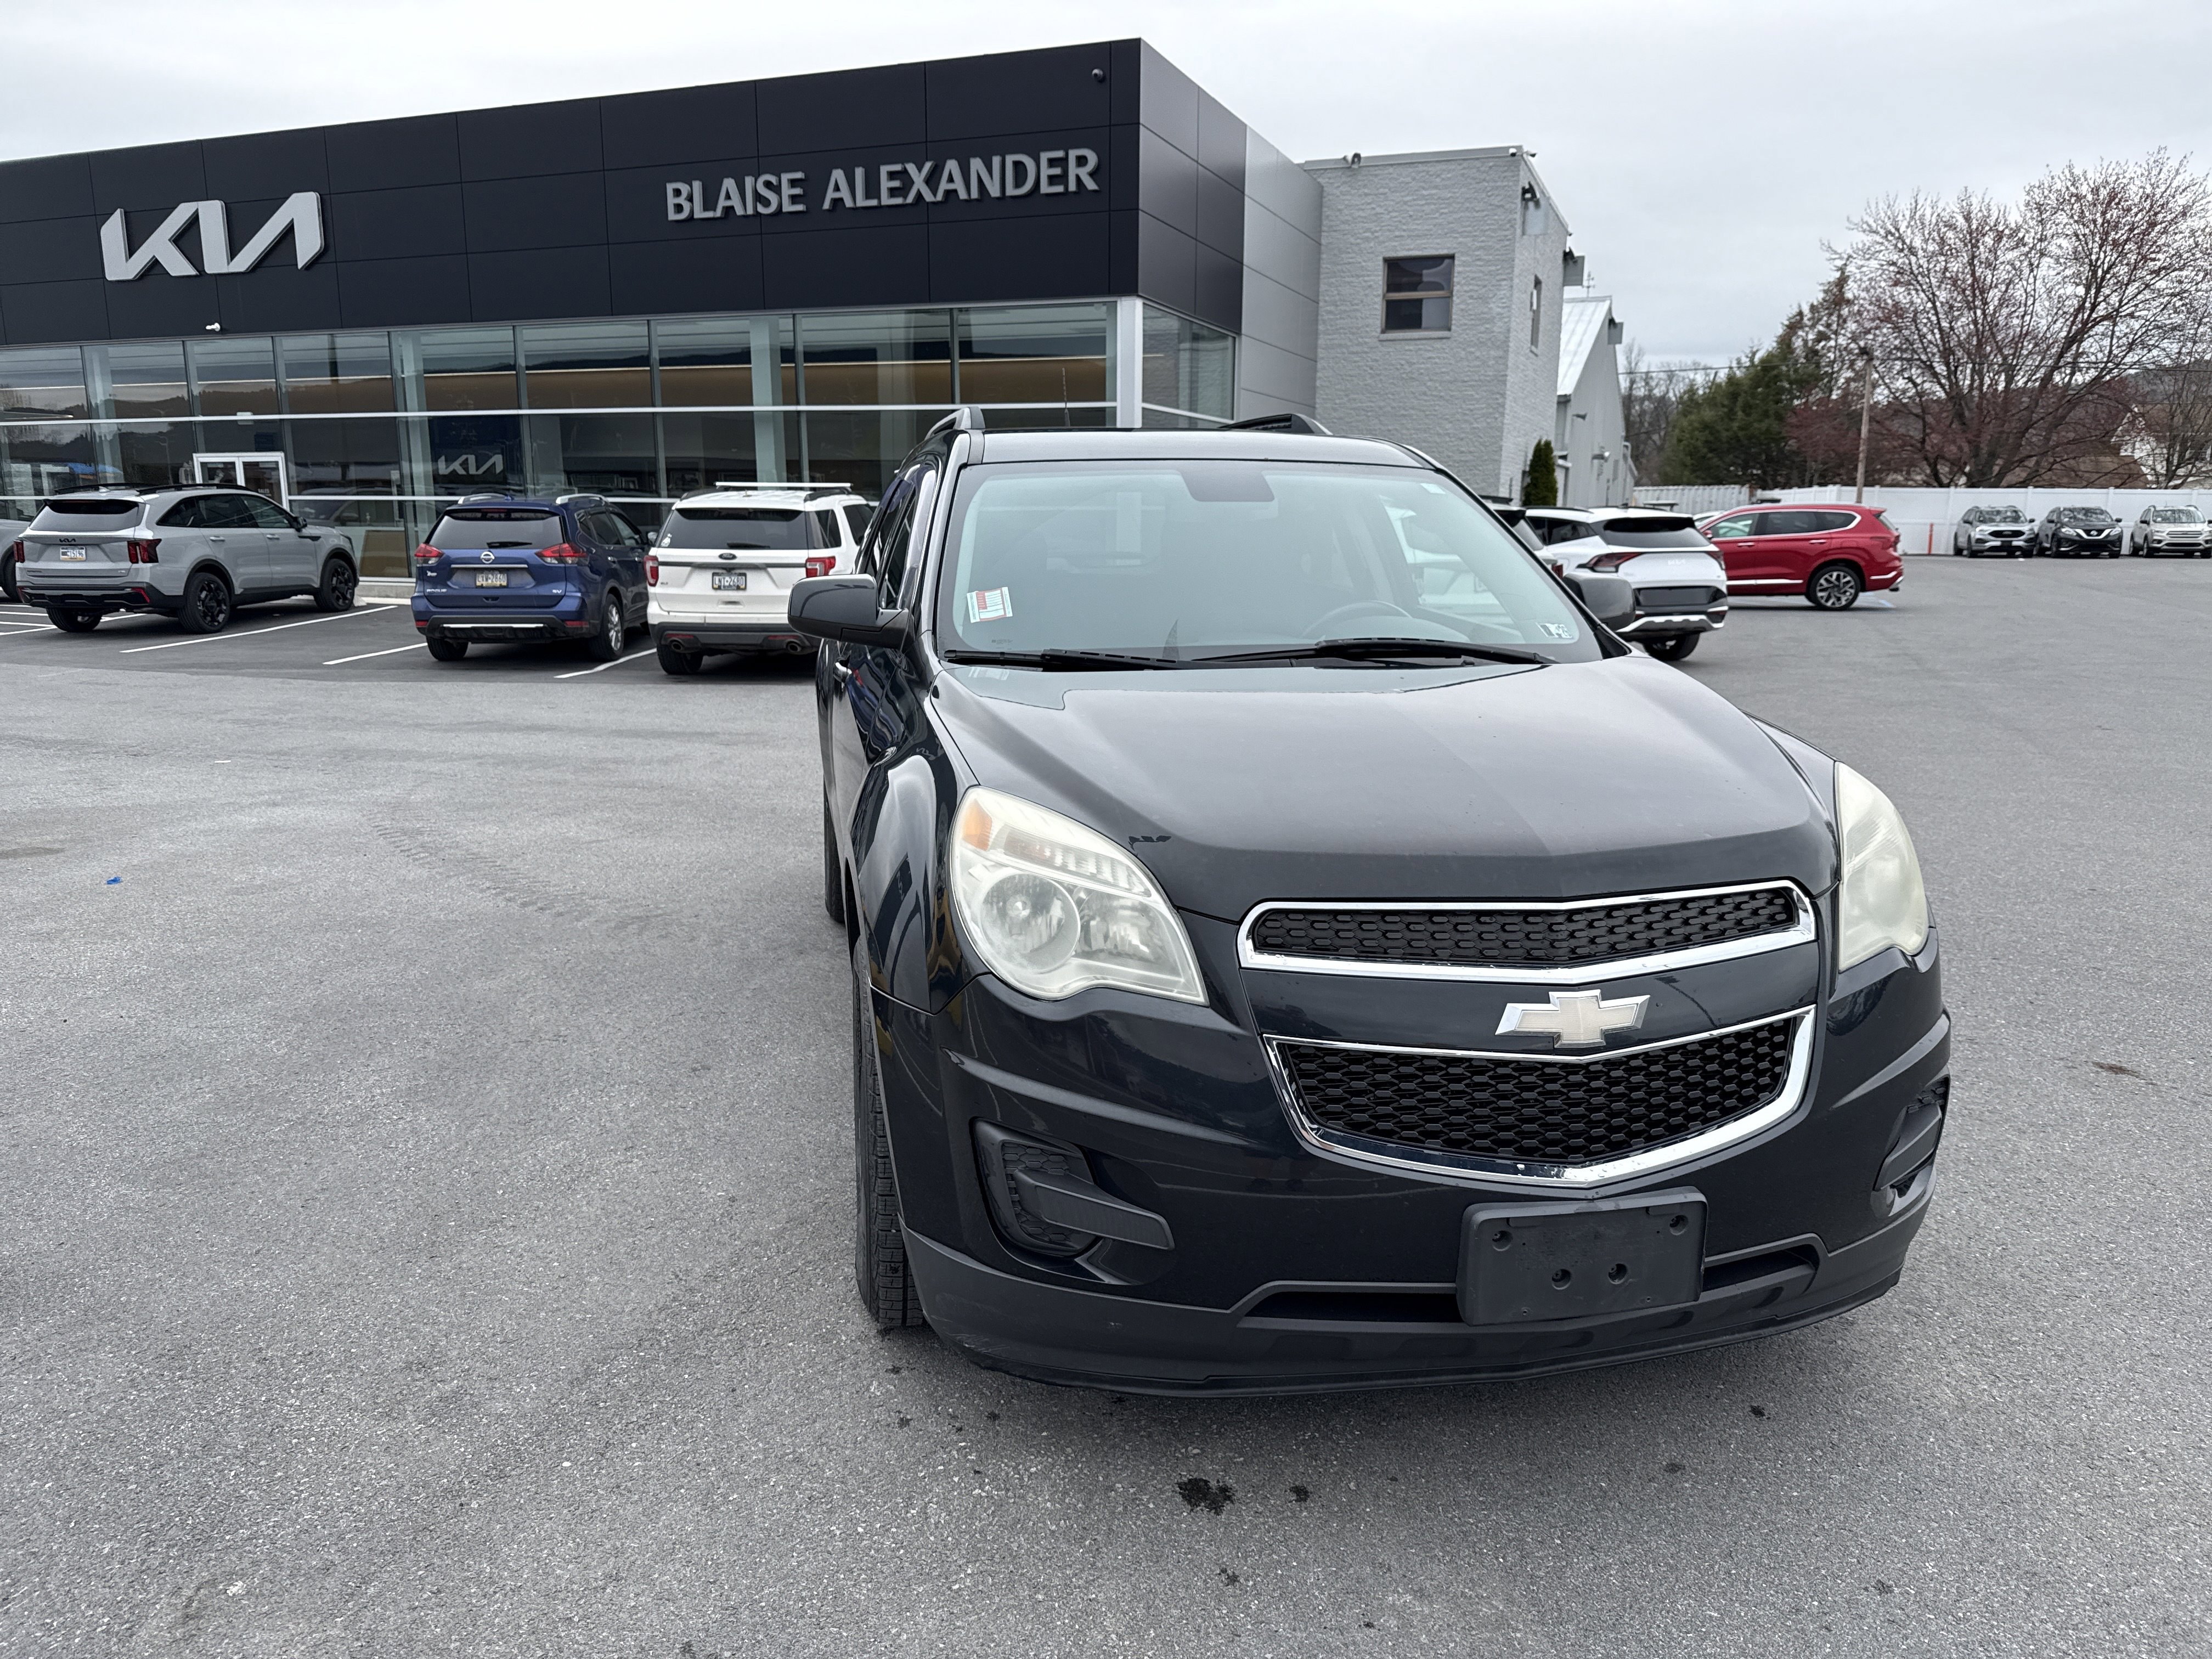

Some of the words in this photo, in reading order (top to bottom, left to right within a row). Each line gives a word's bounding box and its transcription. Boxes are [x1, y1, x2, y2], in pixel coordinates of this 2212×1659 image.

[665, 170, 806, 221] BLAISE
[822, 148, 1099, 210] ALEXANDER
[100, 191, 325, 281] KIA
[438, 454, 504, 475] KIA
